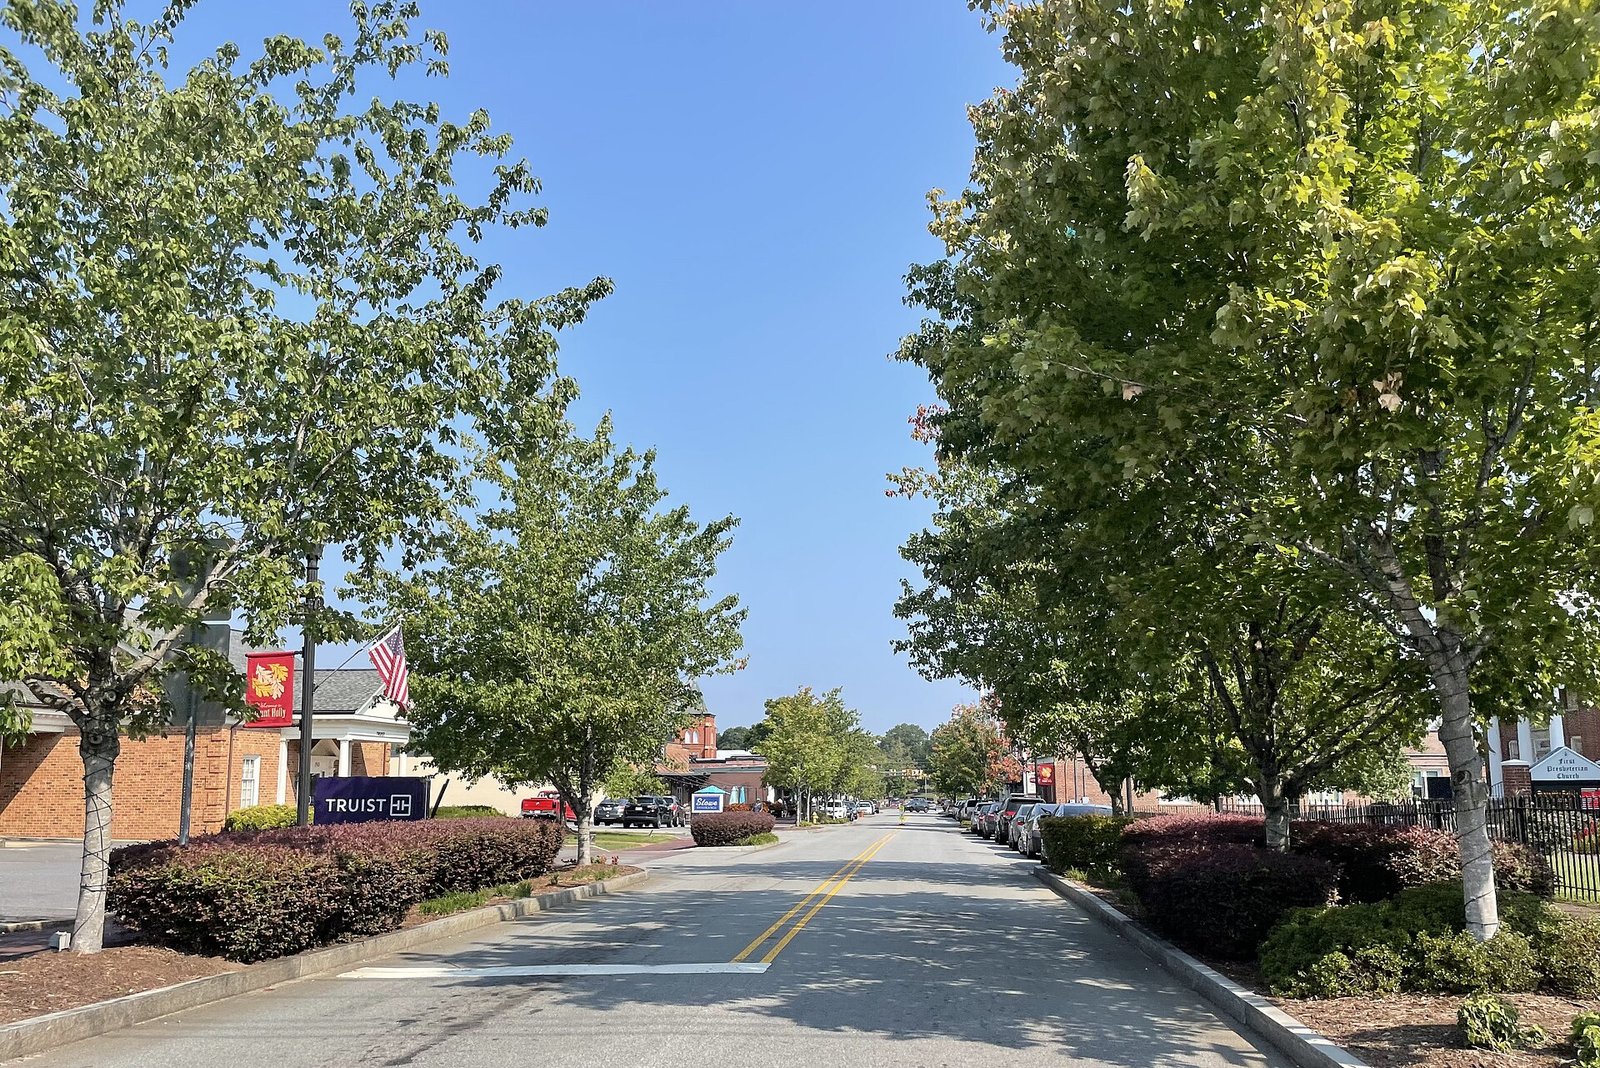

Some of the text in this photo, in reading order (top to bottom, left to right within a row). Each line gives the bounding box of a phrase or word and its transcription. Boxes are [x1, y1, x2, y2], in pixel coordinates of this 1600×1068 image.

[271, 707, 286, 719] Holly
[1547, 765, 1588, 773] Presbyterian
[325, 798, 387, 812] TRUIST
